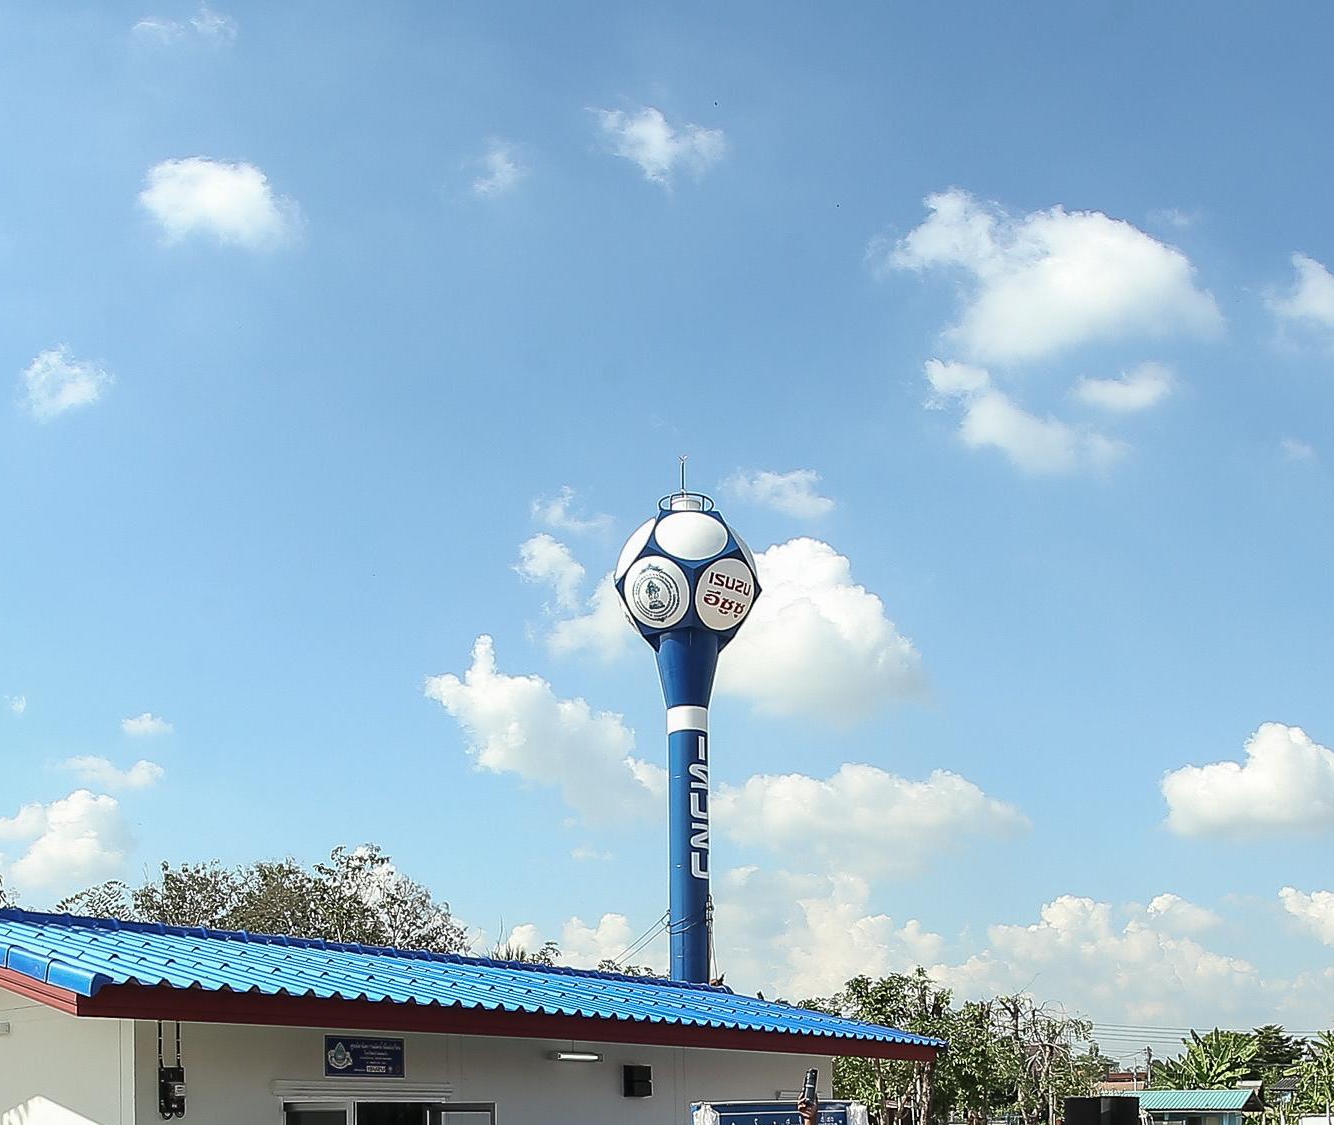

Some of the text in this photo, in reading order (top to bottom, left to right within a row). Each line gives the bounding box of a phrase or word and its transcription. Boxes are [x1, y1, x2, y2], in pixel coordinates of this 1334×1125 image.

[708, 571, 752, 597] ISUZU
[703, 589, 746, 619] อีซูซุ
[688, 735, 709, 880] ISUZU
